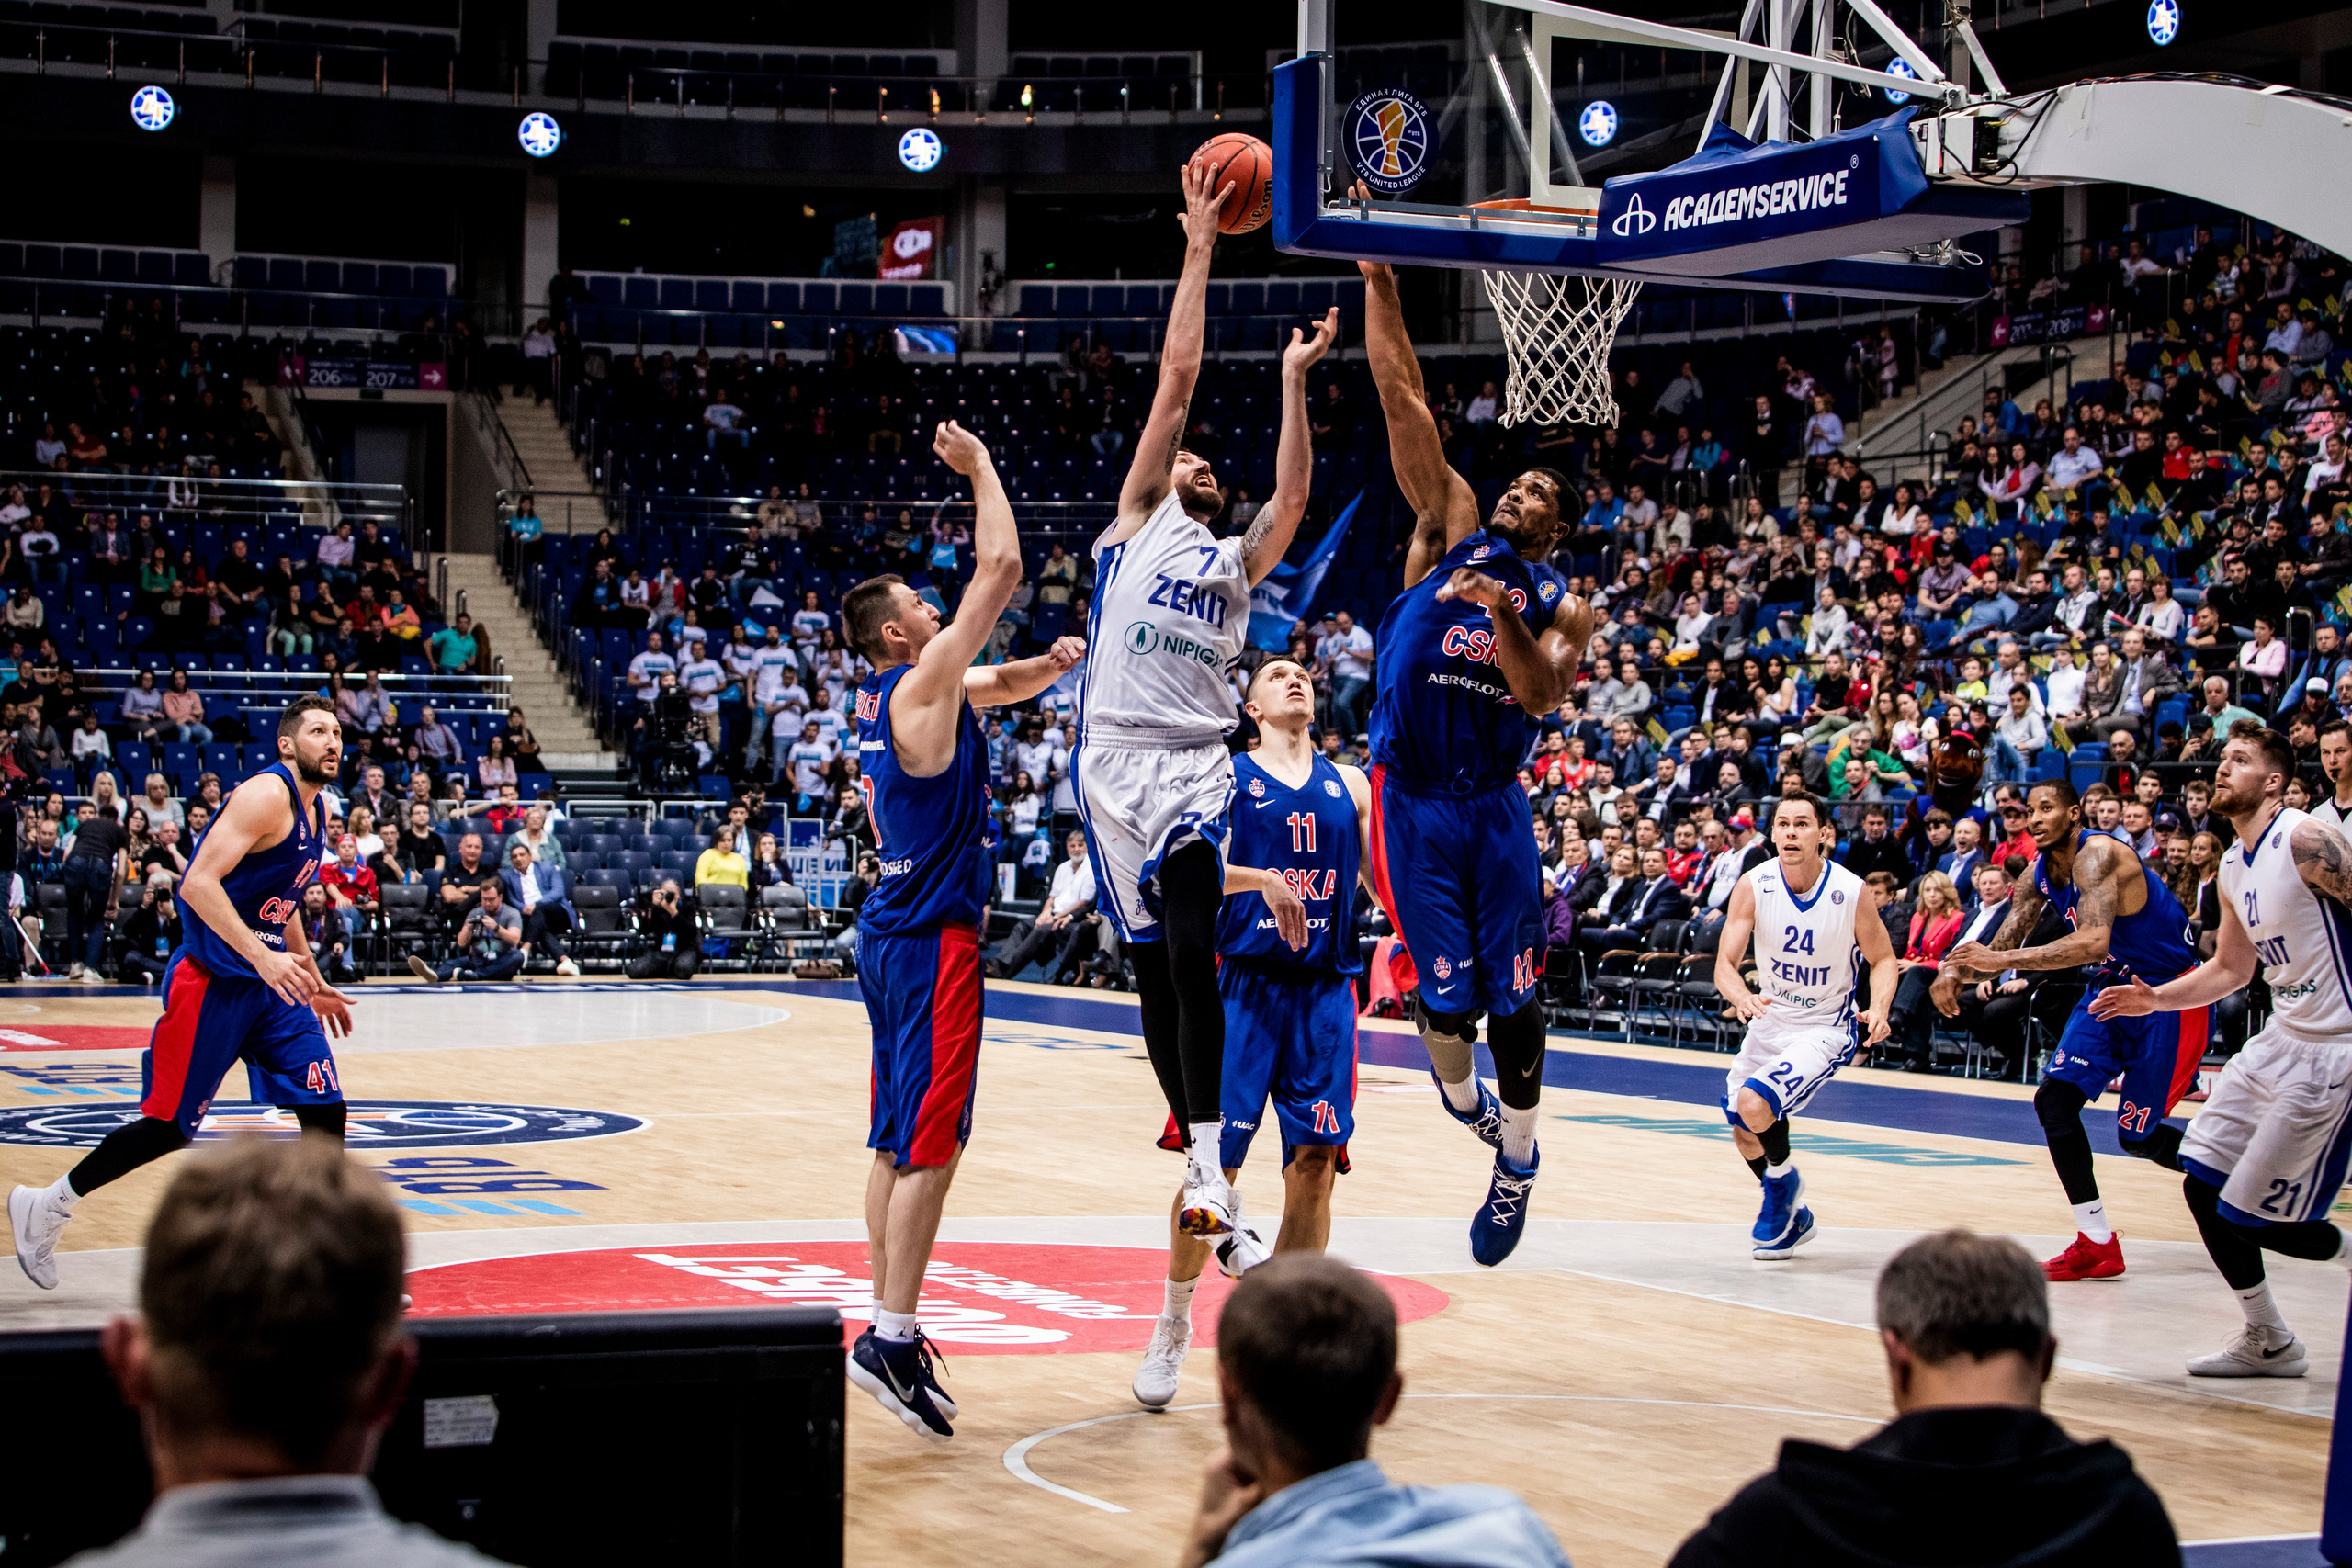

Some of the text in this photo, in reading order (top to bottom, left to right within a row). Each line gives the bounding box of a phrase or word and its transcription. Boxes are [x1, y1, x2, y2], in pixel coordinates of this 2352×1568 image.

[1355, 88, 1428, 117] ЕДИНАЯ ЛИГА ВТБ
[1356, 162, 1426, 188] VTB UNITED LEAGUE
[309, 368, 341, 384] 206
[367, 371, 397, 386] 207
[1197, 546, 1220, 577] 7
[1147, 572, 1229, 630] ZENIT
[1427, 672, 1504, 697] AEROFLOT
[1287, 811, 1317, 852] 11
[2245, 888, 2260, 928] 21
[1782, 925, 1815, 956] 24
[1512, 947, 1534, 995] 42
[1770, 957, 1831, 987] ZENIT
[307, 1059, 338, 1094] 41
[1767, 1061, 1804, 1097] 24
[1311, 1100, 1340, 1134] 11
[2119, 1101, 2151, 1134] 21
[2259, 1179, 2302, 1218] 21
